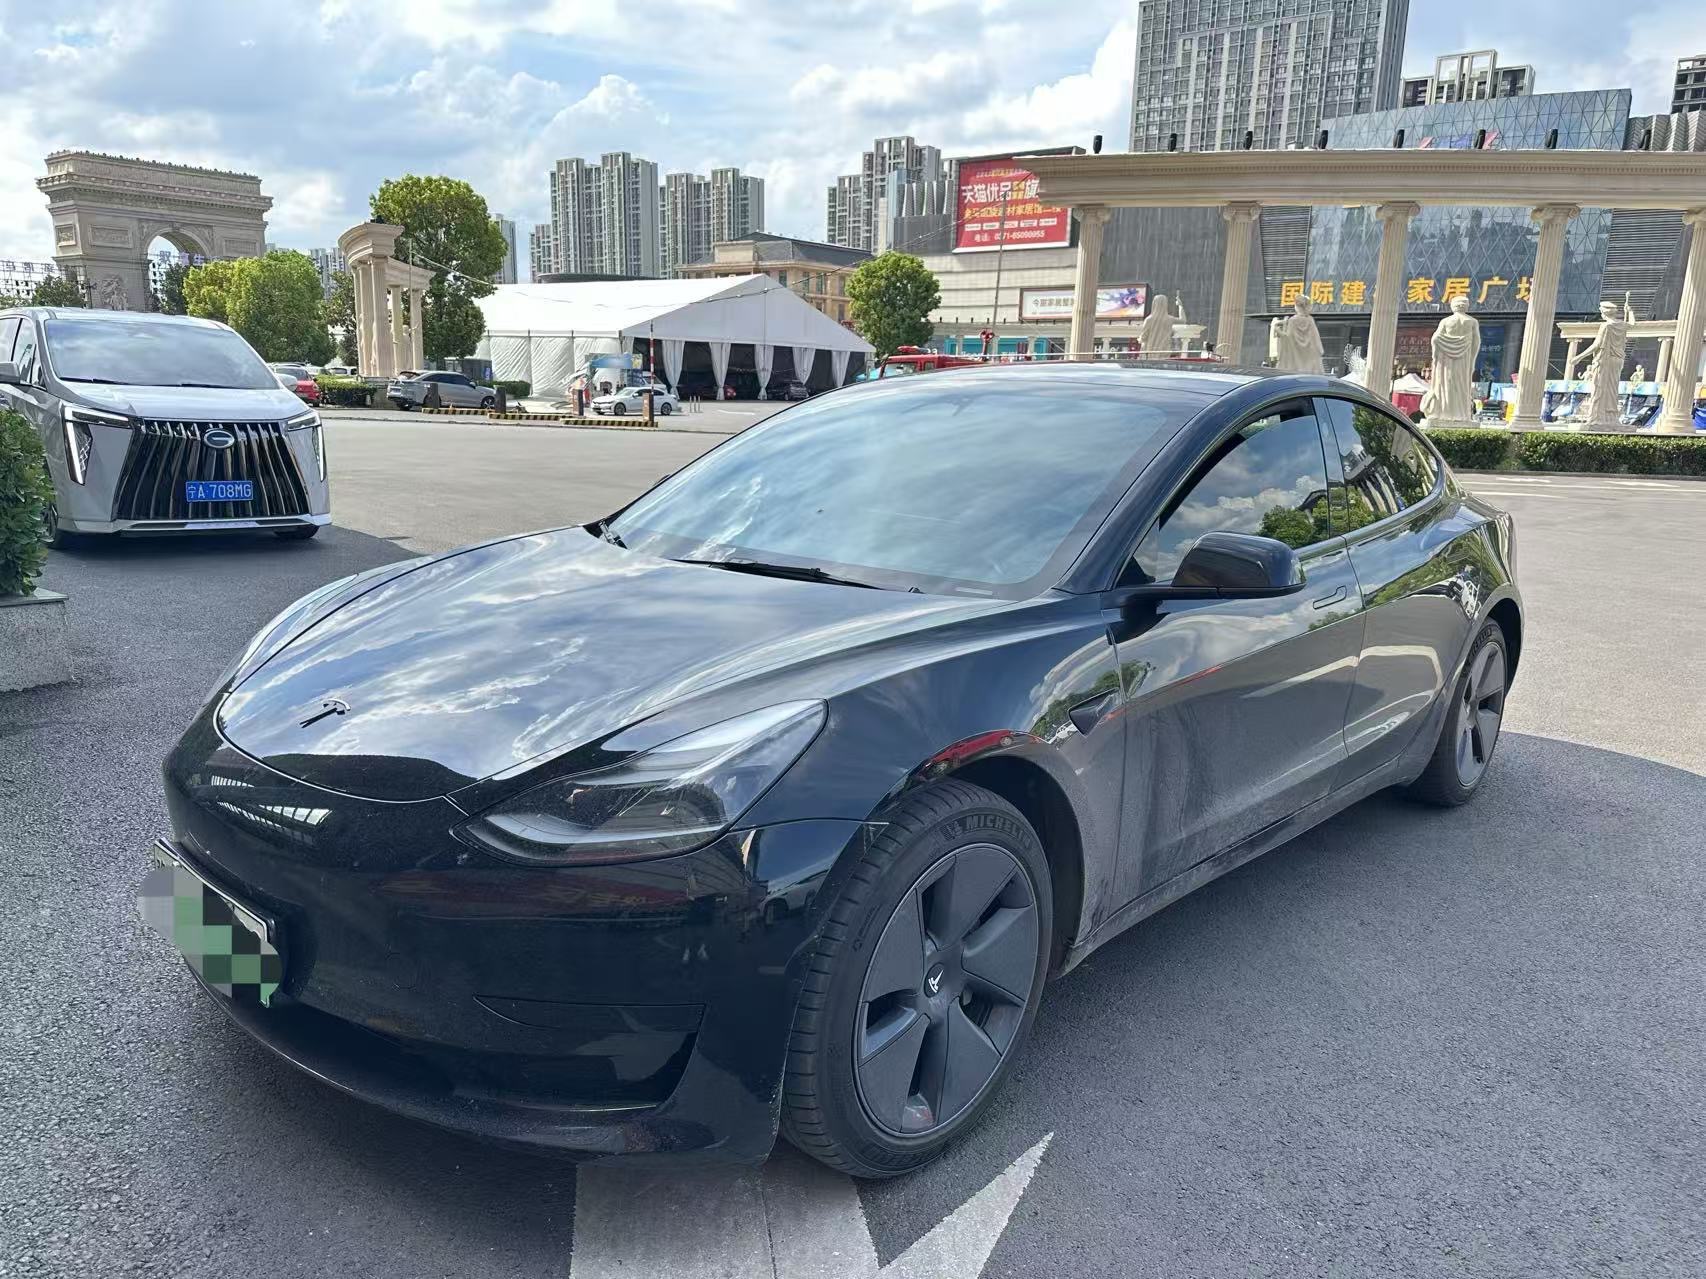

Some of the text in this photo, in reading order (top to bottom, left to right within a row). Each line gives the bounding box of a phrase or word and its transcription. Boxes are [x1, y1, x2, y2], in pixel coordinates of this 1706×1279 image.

[1280, 276, 1533, 307] 国际建家居广
